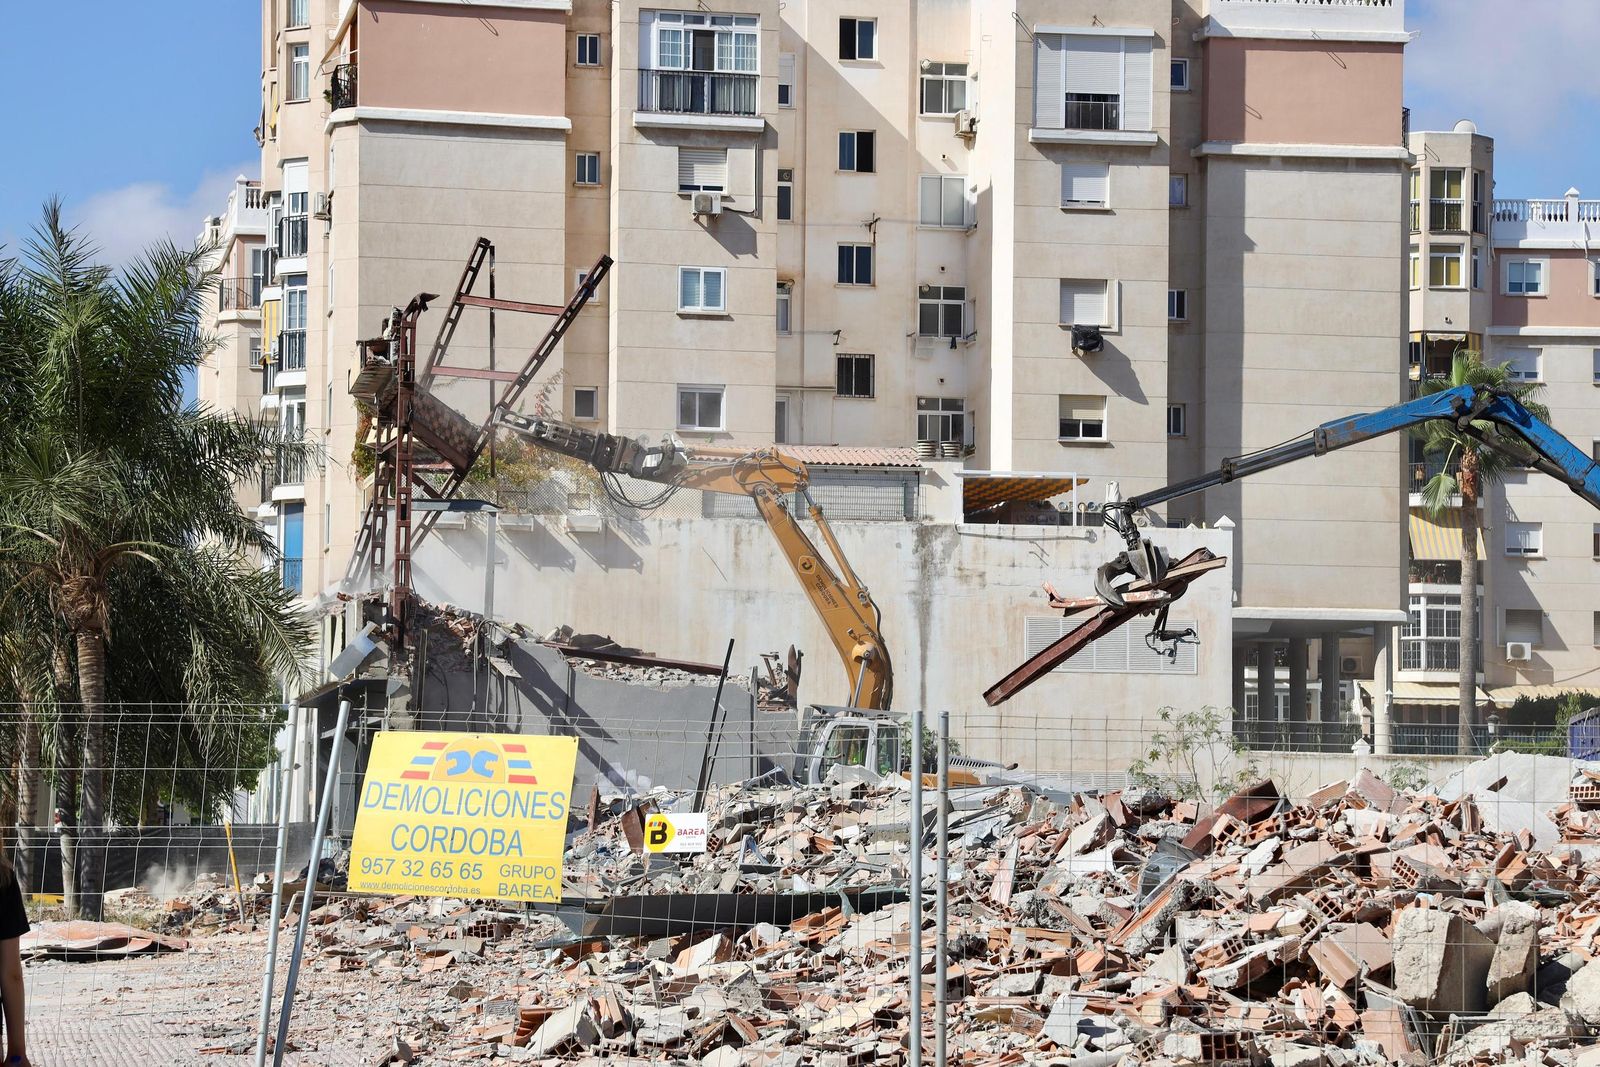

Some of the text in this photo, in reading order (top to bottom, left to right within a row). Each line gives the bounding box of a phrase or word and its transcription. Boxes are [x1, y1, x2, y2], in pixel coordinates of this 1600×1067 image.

[363, 780, 566, 820] DEMOLICIONES
[391, 823, 523, 857] CORDOBA
[677, 828, 705, 836] BAREA
[361, 856, 483, 881] 957 32 65 65
[499, 863, 556, 881] GRUPO
[359, 880, 481, 895] www.demolicionescordoba.es
[498, 882, 555, 899] BAREA
